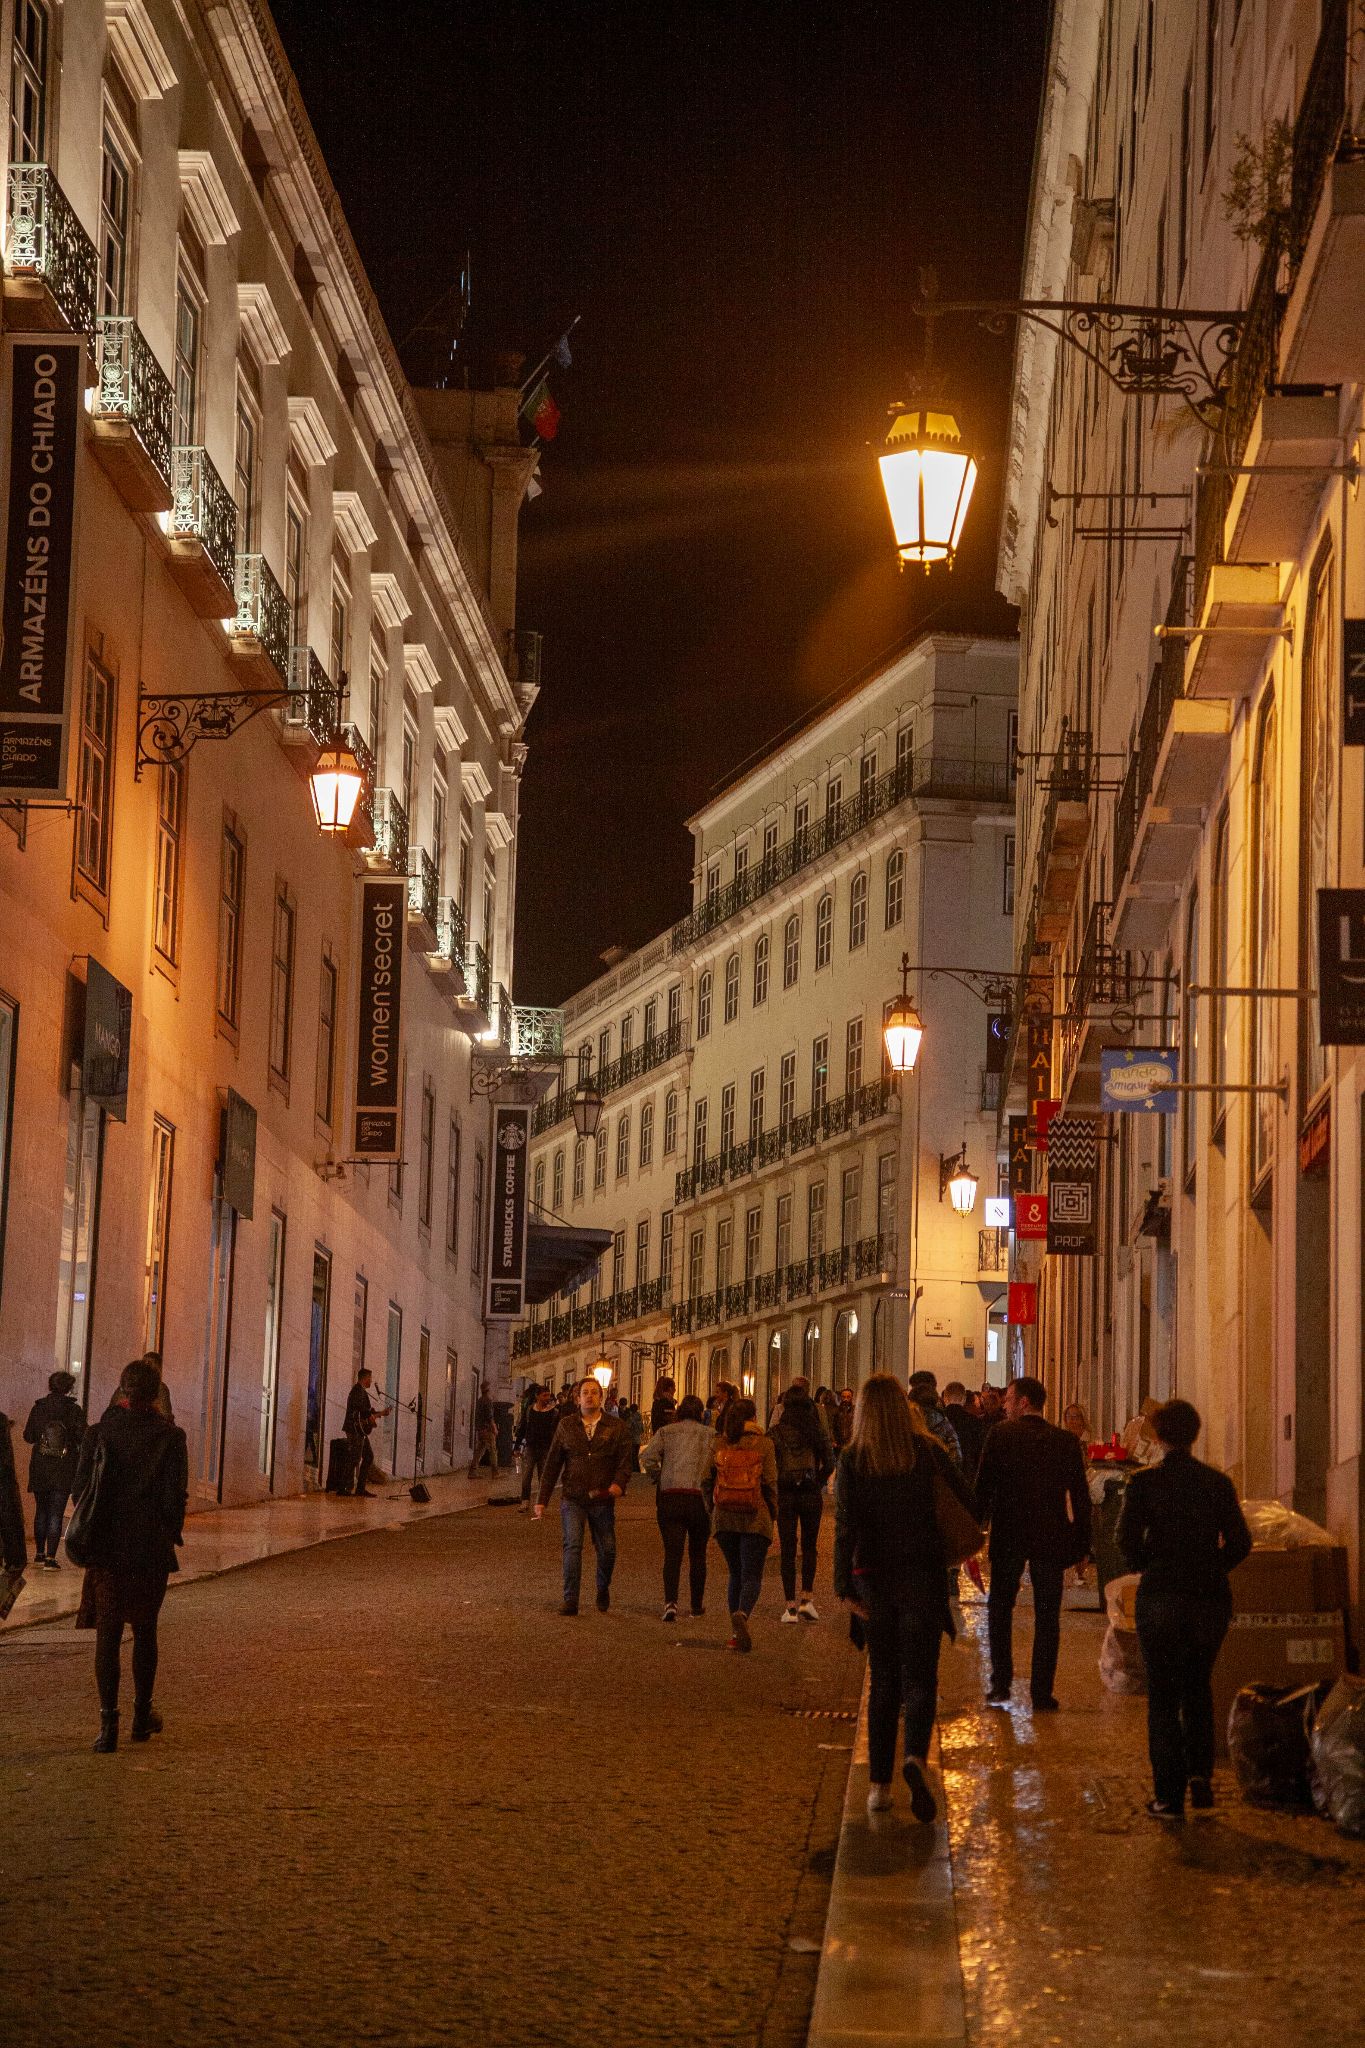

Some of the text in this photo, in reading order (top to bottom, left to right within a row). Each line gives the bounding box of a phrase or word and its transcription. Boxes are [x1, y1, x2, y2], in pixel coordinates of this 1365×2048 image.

[18, 353, 57, 704] ARMAZÉNS DO CHIADO
[3, 736, 52, 747] ARMAZÉNS
[2, 745, 17, 753] DO
[1, 753, 37, 762] CHIADO
[370, 902, 393, 1087] women'secret
[503, 1154, 516, 1267] STARBUCKS COFFEE
[1054, 1235, 1086, 1247] PROF
